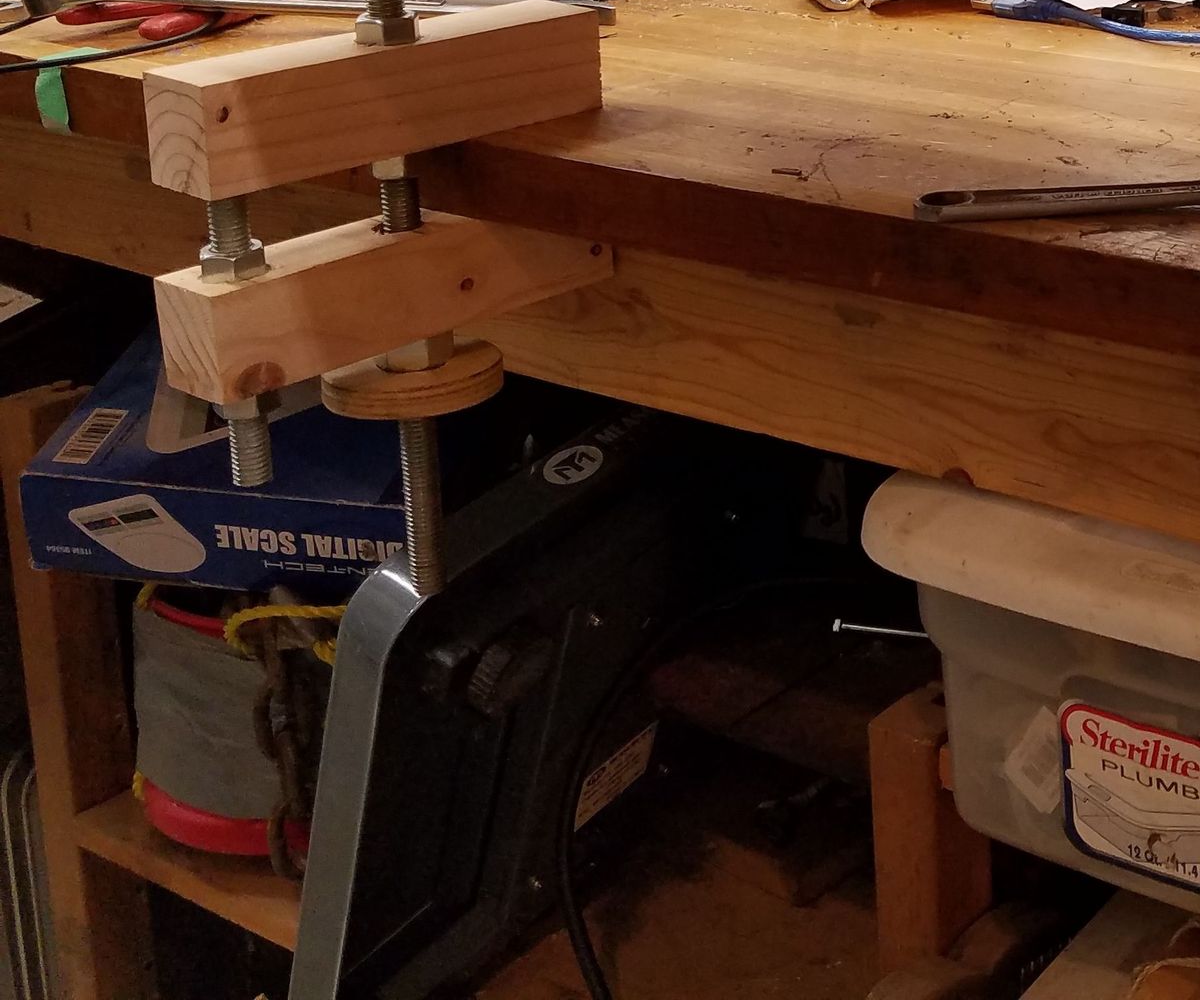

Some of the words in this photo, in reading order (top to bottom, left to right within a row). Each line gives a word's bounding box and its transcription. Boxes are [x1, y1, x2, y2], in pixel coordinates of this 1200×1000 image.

[216, 524, 298, 554] SCALE
[301, 533, 404, 563] DIGITAL
[1079, 718, 1200, 780] Sterilite
[1127, 843, 1141, 859] 12
[1174, 860, 1199, 879] 11.4
